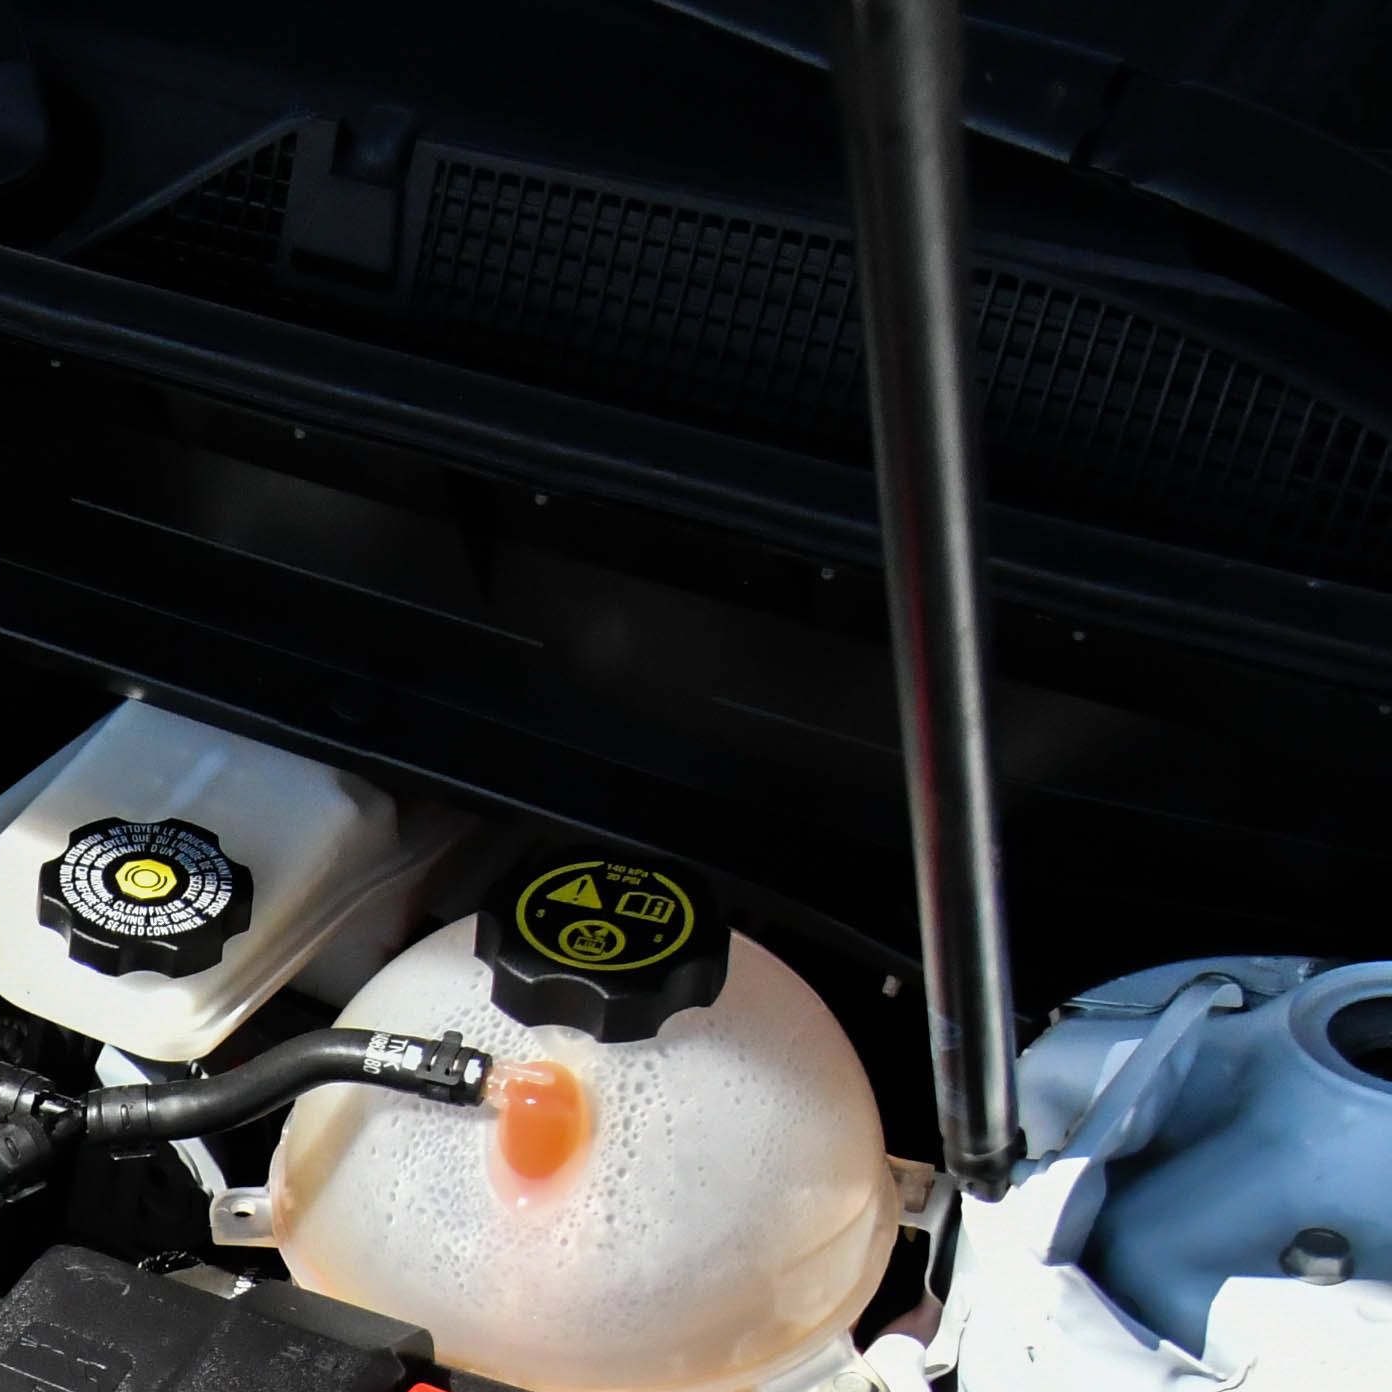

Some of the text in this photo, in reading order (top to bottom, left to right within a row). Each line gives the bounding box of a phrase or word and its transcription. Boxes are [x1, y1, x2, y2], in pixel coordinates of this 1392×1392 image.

[108, 824, 160, 837] NETTOYER
[162, 826, 175, 837] LE
[131, 834, 151, 844] QUE
[155, 835, 170, 845] DU
[95, 843, 145, 868] PROVENANT
[198, 859, 214, 872] DE
[213, 856, 232, 879] AVANT
[74, 866, 88, 881] CAP
[203, 872, 217, 888] FREIN
[220, 880, 233, 891] LA
[75, 881, 101, 909] BEFORE
[61, 881, 79, 905] FLUID
[73, 900, 100, 923] FROM
[96, 916, 105, 928] A
[105, 919, 145, 937] SEALED
[114, 900, 148, 915] CLEAN
[149, 899, 185, 915] FILLER
[150, 914, 170, 926] USE
[170, 908, 197, 924] ONLY
